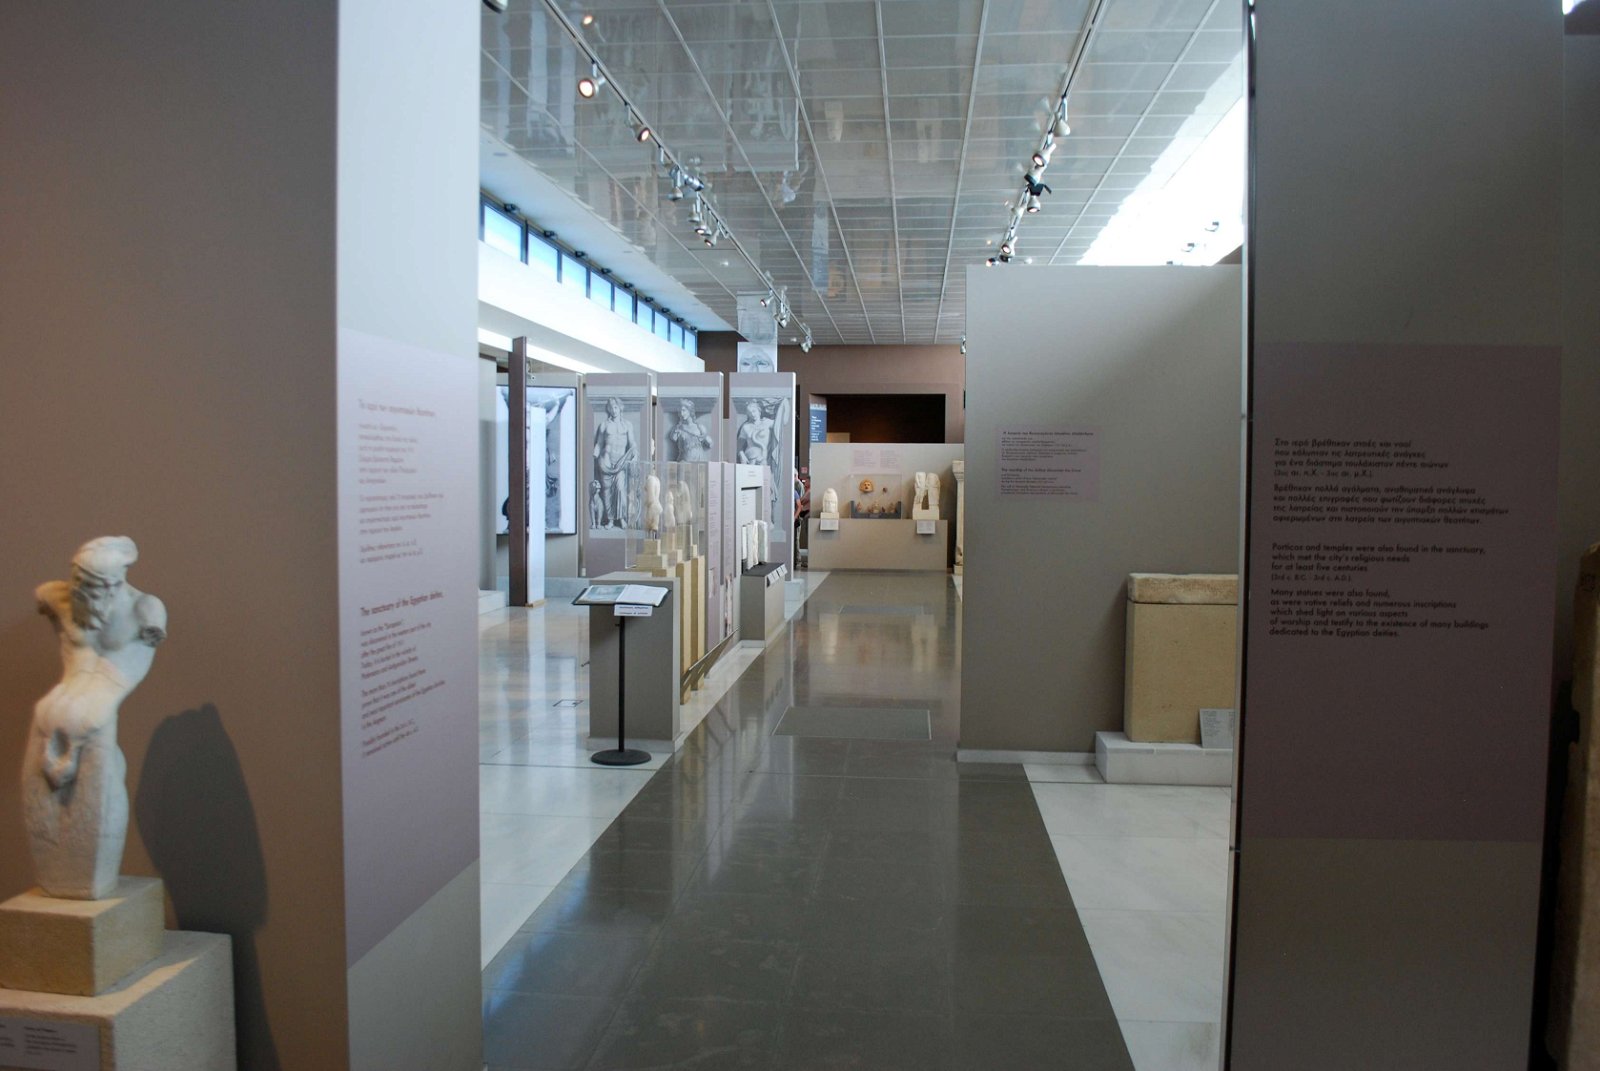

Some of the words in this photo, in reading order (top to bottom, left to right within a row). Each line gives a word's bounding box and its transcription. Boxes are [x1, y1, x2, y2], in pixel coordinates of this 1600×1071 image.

[1305, 543, 1321, 551] and
[1323, 544, 1353, 553] temples
[1378, 544, 1394, 552] also
[1396, 544, 1419, 552] found
[1431, 545, 1443, 553] the
[1272, 553, 1294, 561] which
[1314, 553, 1326, 561] the
[1351, 554, 1384, 563] religious
[1387, 554, 1410, 562] needs
[1272, 562, 1282, 570] for
[1296, 563, 1313, 571] least
[1316, 563, 1330, 571] five
[1332, 564, 1368, 572] centuries
[1271, 588, 1293, 597] Many
[1347, 589, 1363, 597] also
[1330, 599, 1353, 607] reliefs
[1355, 599, 1371, 607] and
[1413, 600, 1456, 609] inscriptions
[1270, 608, 1292, 616] which
[1296, 608, 1314, 616] shed
[1316, 608, 1333, 617] light
[1269, 617, 1278, 625] of
[1281, 618, 1311, 627] worship
[1313, 618, 1328, 626] and
[1331, 618, 1353, 627] testify
[1366, 618, 1378, 626] the
[1419, 619, 1428, 627] of
[1430, 621, 1451, 629] many
[1454, 619, 1488, 630] buildings
[1269, 627, 1308, 636] dedicated
[1321, 628, 1333, 636] the
[1336, 628, 1370, 637] Egyptian
